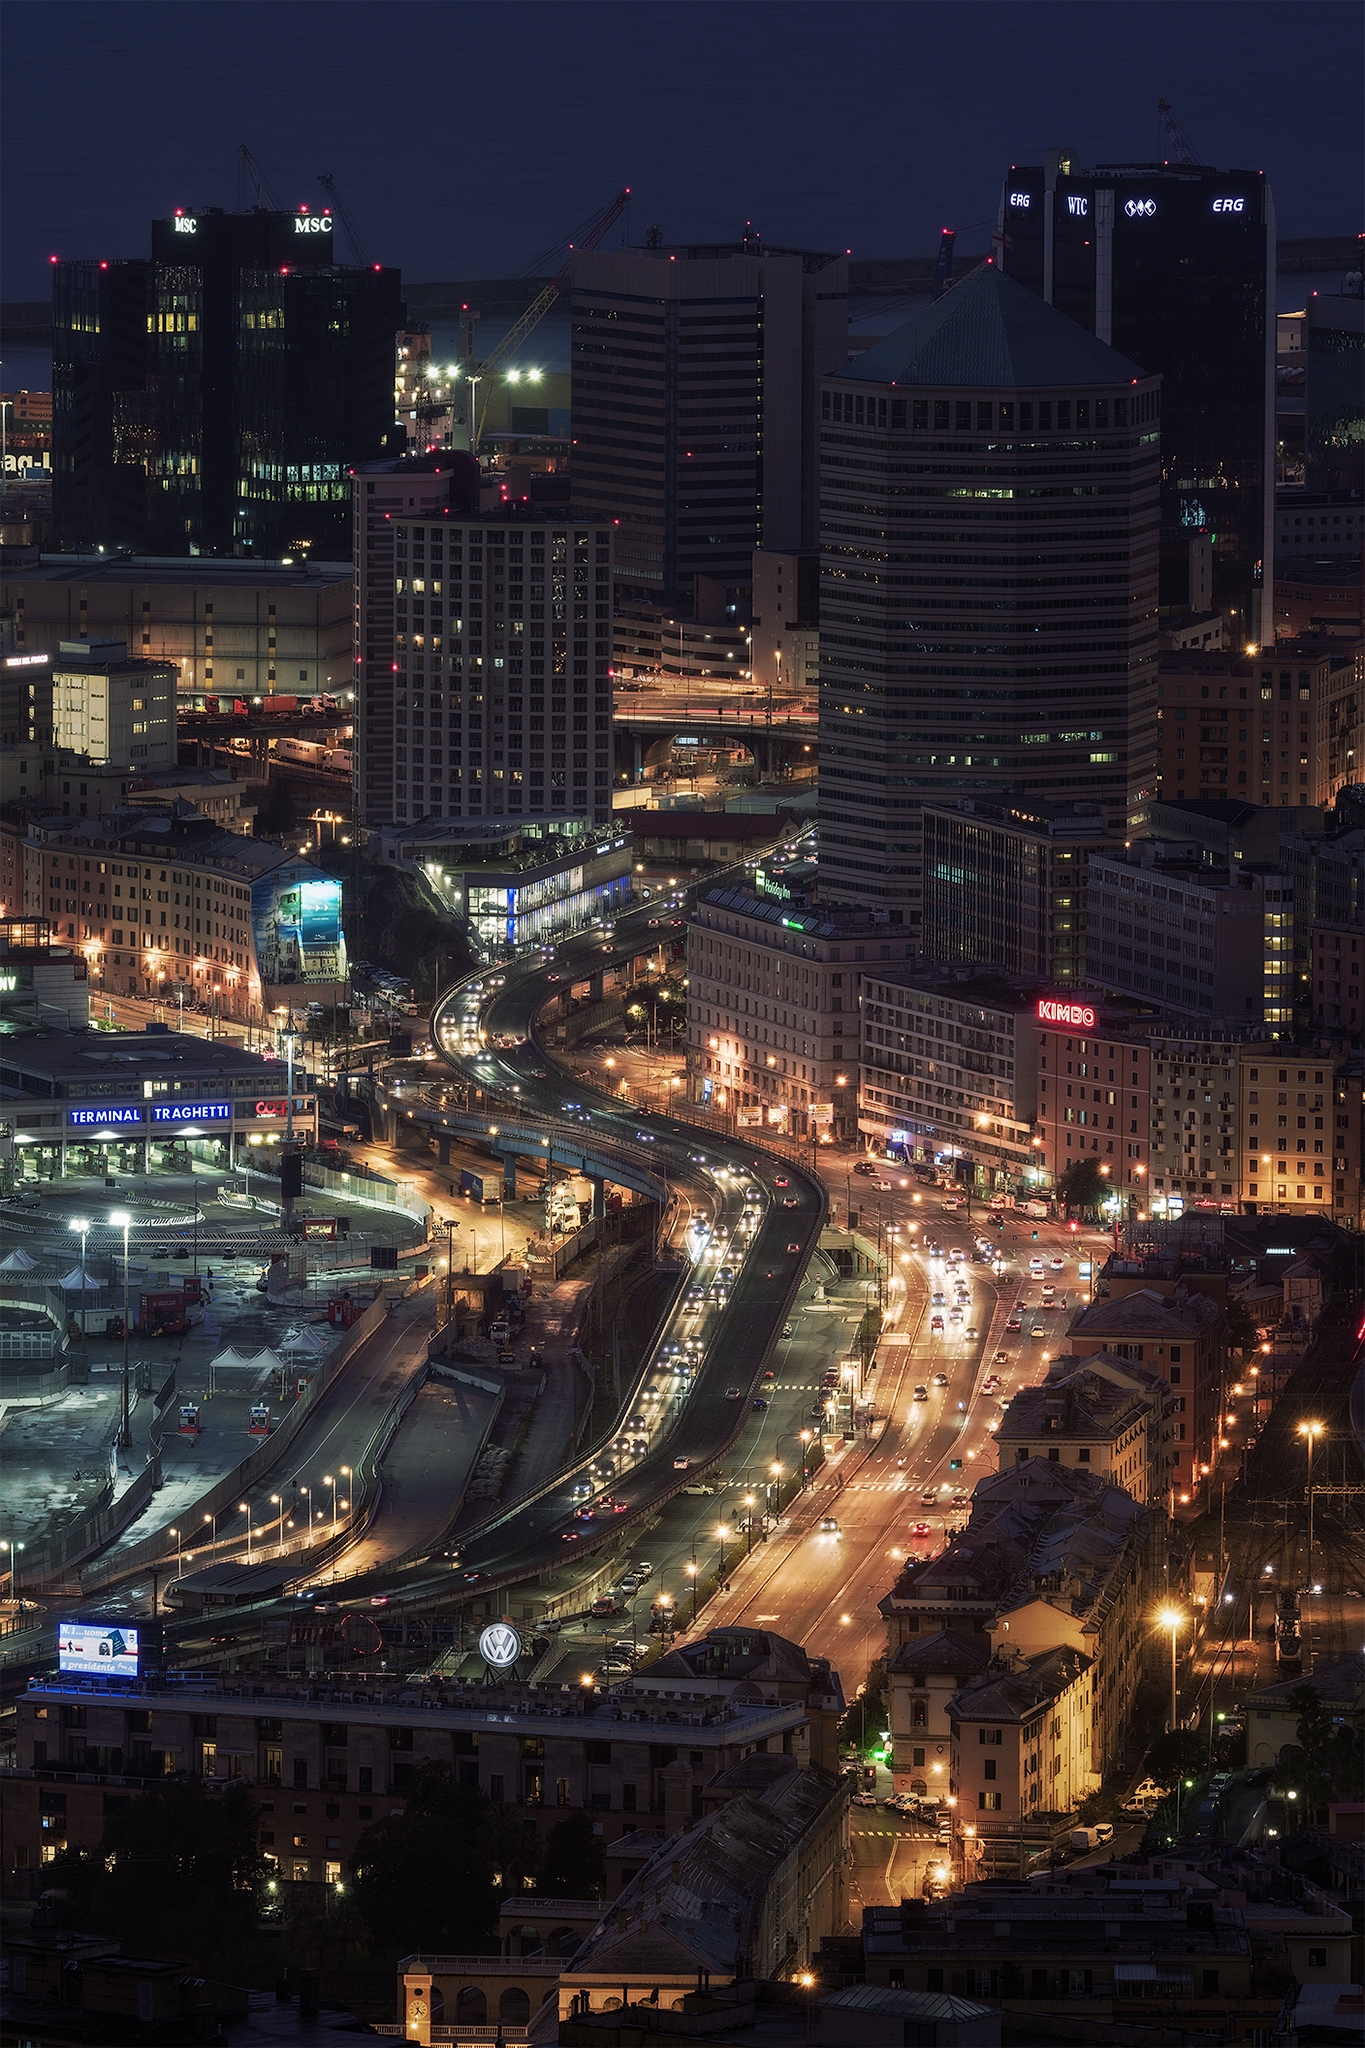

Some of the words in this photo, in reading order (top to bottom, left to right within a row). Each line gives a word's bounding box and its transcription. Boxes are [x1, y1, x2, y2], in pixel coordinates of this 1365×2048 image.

[1010, 193, 1030, 208] ERG
[1067, 196, 1087, 216] WTC
[1212, 198, 1244, 212] ERG
[175, 217, 197, 234] MSC
[294, 217, 333, 233] MSC
[765, 878, 783, 900] Holiday
[782, 883, 791, 899] Inn
[1039, 1001, 1095, 1026] KIMBO
[72, 1108, 141, 1124] TERMINAL
[154, 1105, 229, 1122] TRAGHETTI
[69, 1662, 115, 1672] presidente
